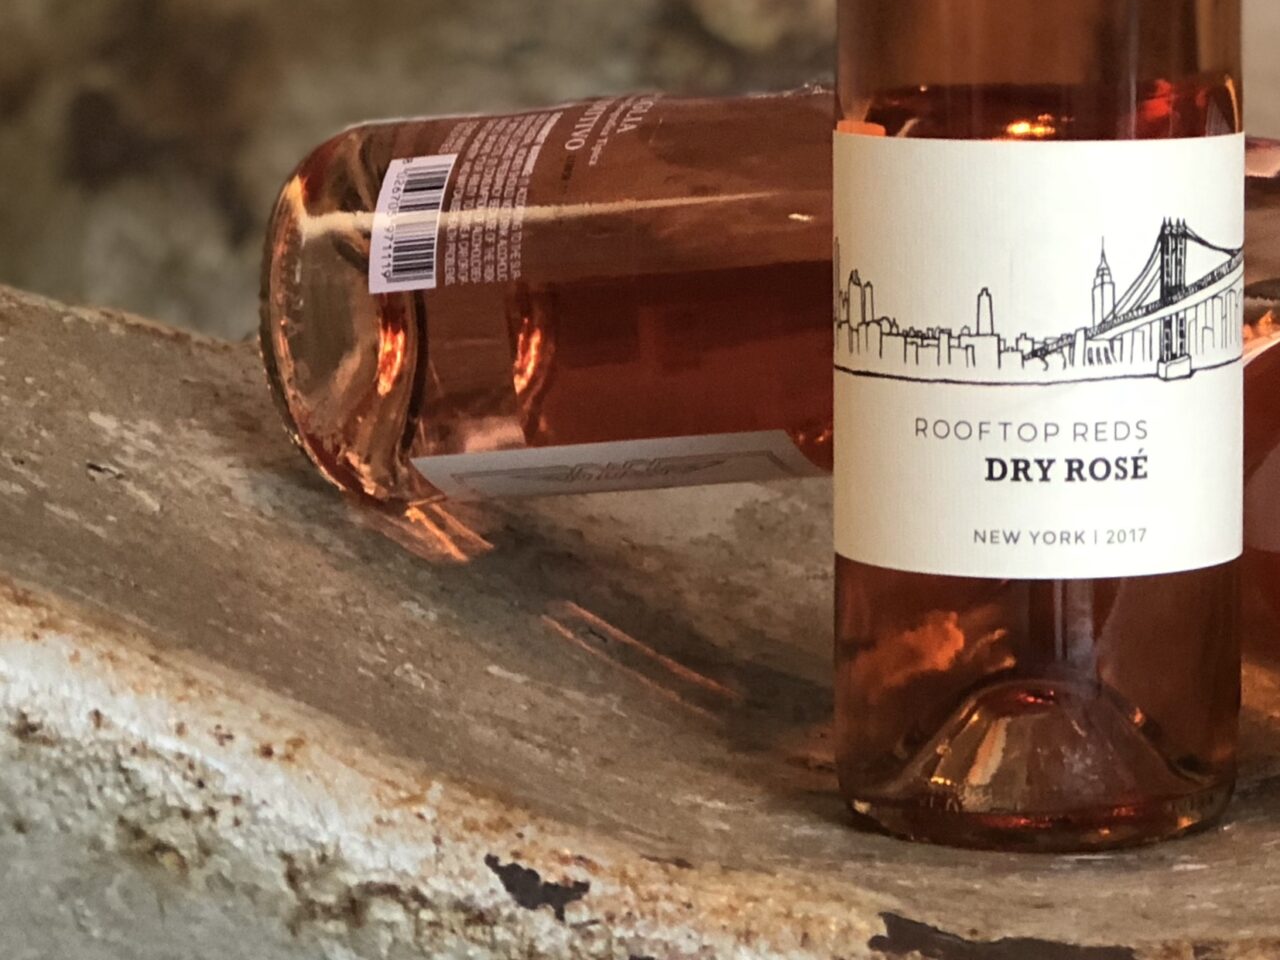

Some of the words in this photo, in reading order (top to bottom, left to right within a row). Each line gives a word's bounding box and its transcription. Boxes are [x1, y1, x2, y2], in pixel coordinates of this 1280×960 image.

[914, 417, 1059, 443] ROOFTOP
[1073, 420, 1147, 442] REDS
[984, 457, 1056, 482] DRY
[1064, 448, 1148, 482] ROSÉ
[973, 529, 1020, 544] NEW
[1029, 531, 1085, 545] YORK
[1107, 528, 1146, 544] 2017
